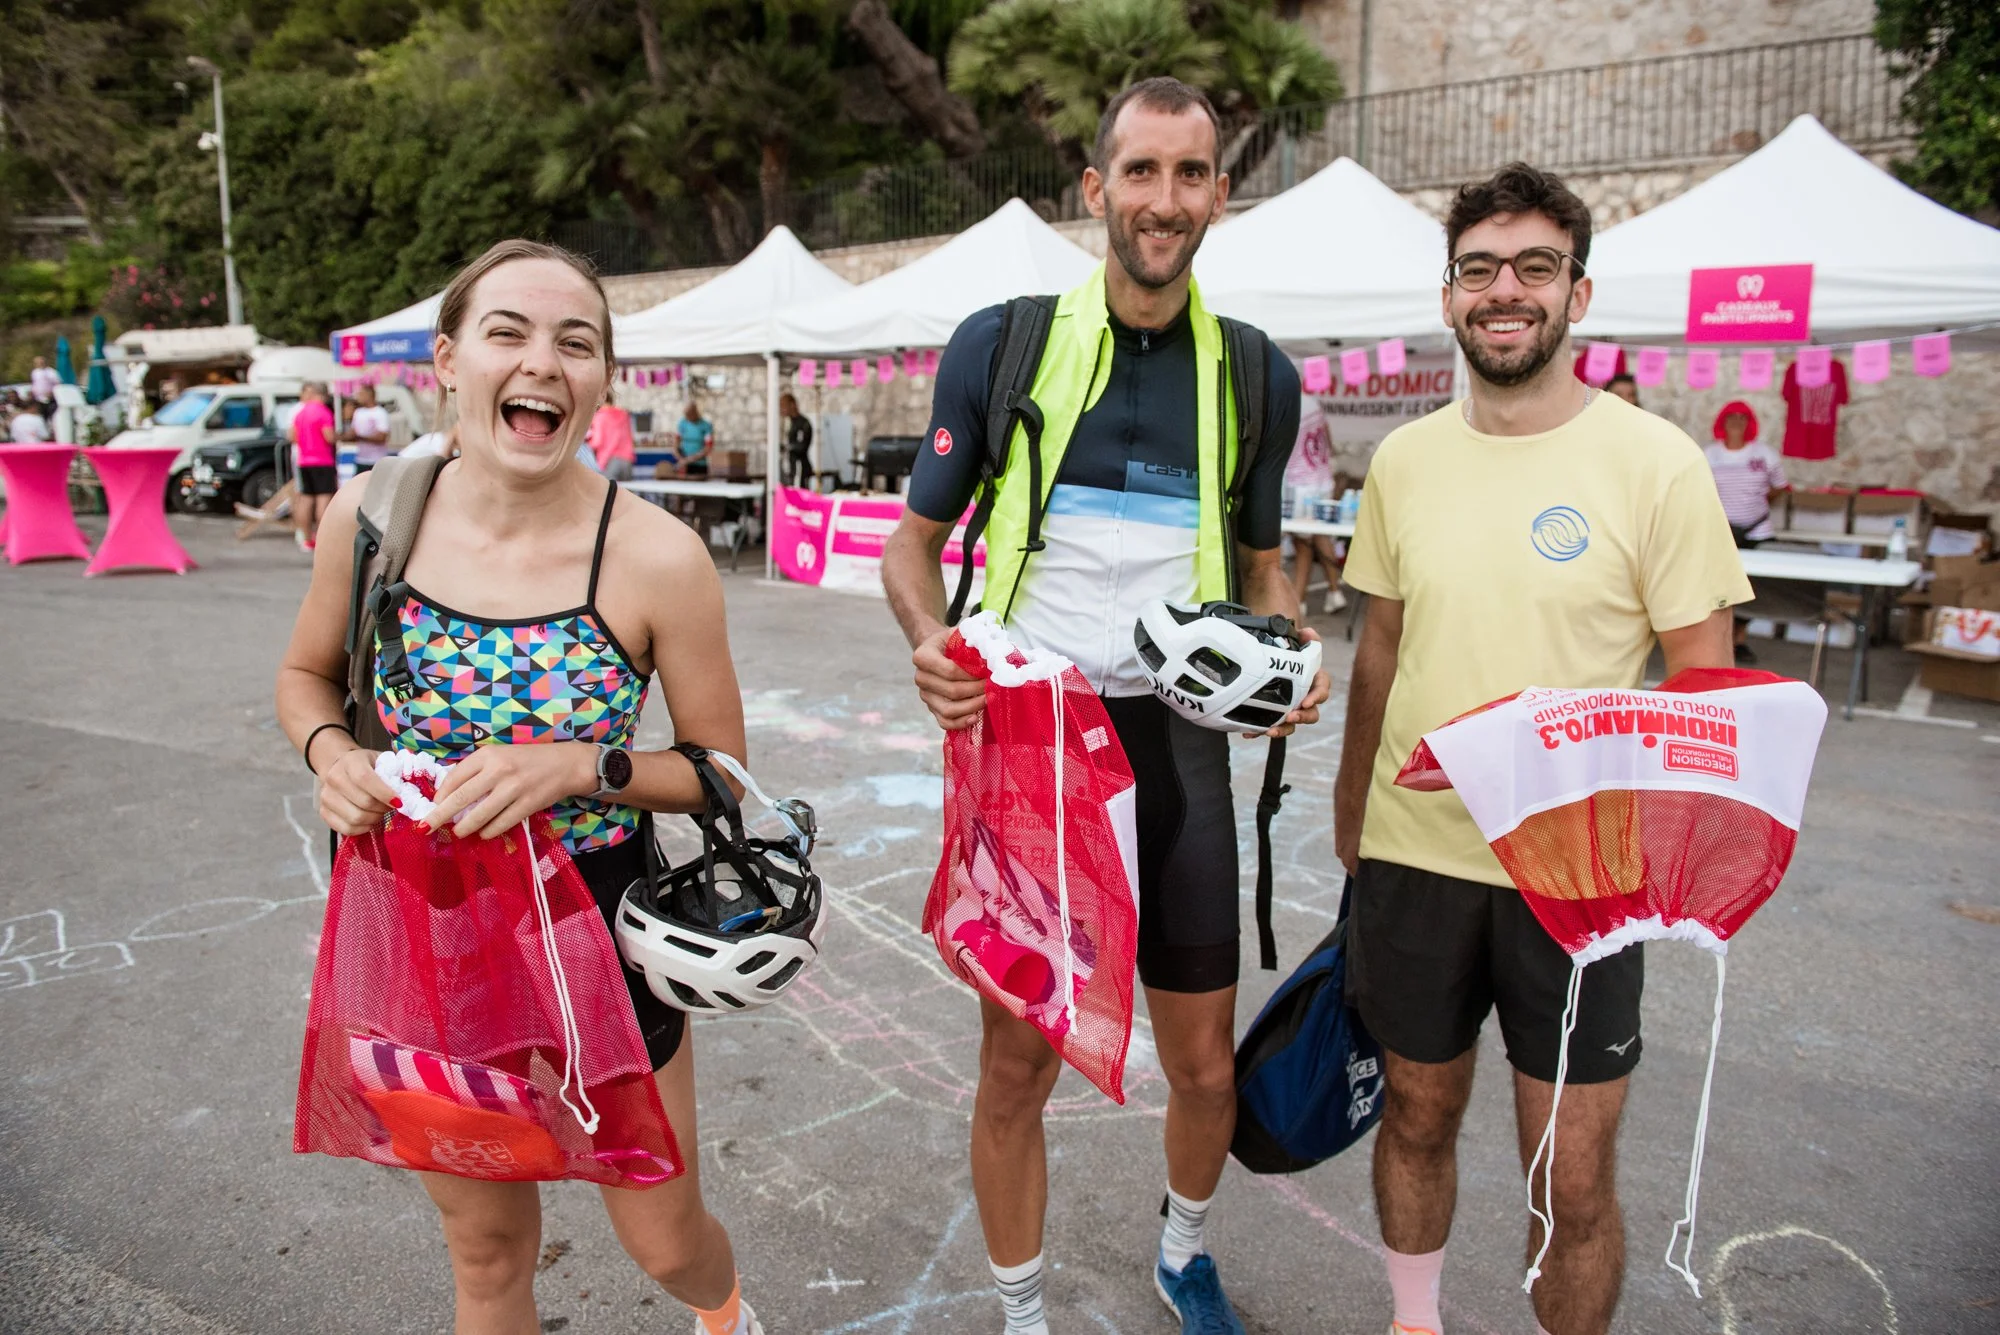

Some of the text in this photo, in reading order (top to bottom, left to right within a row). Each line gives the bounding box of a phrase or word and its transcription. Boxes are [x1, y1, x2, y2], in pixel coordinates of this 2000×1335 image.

[1715, 301, 1780, 314] CADEAUX
[1701, 311, 1794, 325] PARTICIPANTS
[1269, 657, 1304, 676] KASK
[1152, 676, 1205, 714] KASK
[1533, 693, 1668, 724] CHAMPIONSHIP
[1674, 699, 1736, 722] WORLD
[1671, 747, 1709, 759] HYDRATION
[1671, 754, 1733, 774] PRECISION
